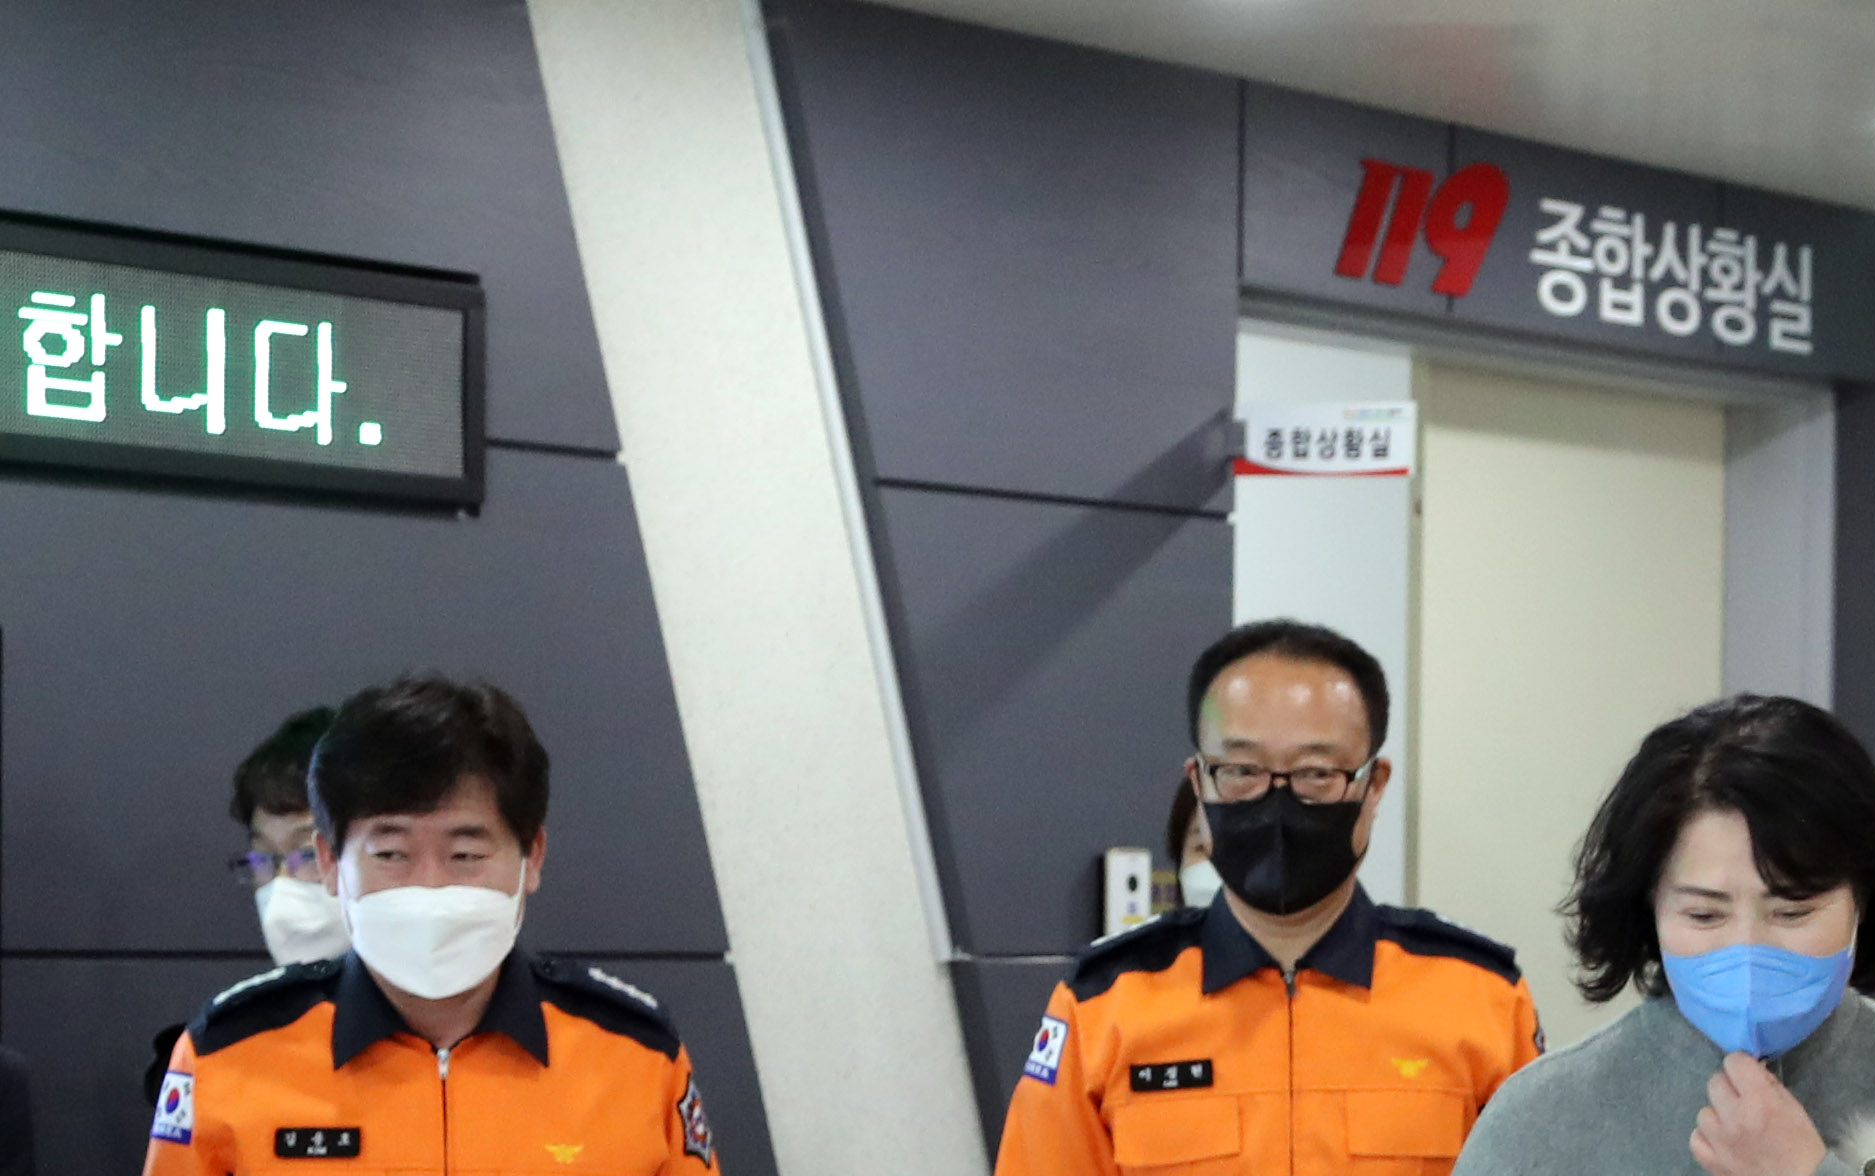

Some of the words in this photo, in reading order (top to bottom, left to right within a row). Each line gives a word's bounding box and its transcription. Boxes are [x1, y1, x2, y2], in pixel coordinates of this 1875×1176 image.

[1335, 158, 1510, 297] 119
[1530, 198, 1813, 356] 종합상황실
[18, 291, 382, 446] 합니다.
[1264, 427, 1391, 459] 종합상황실
